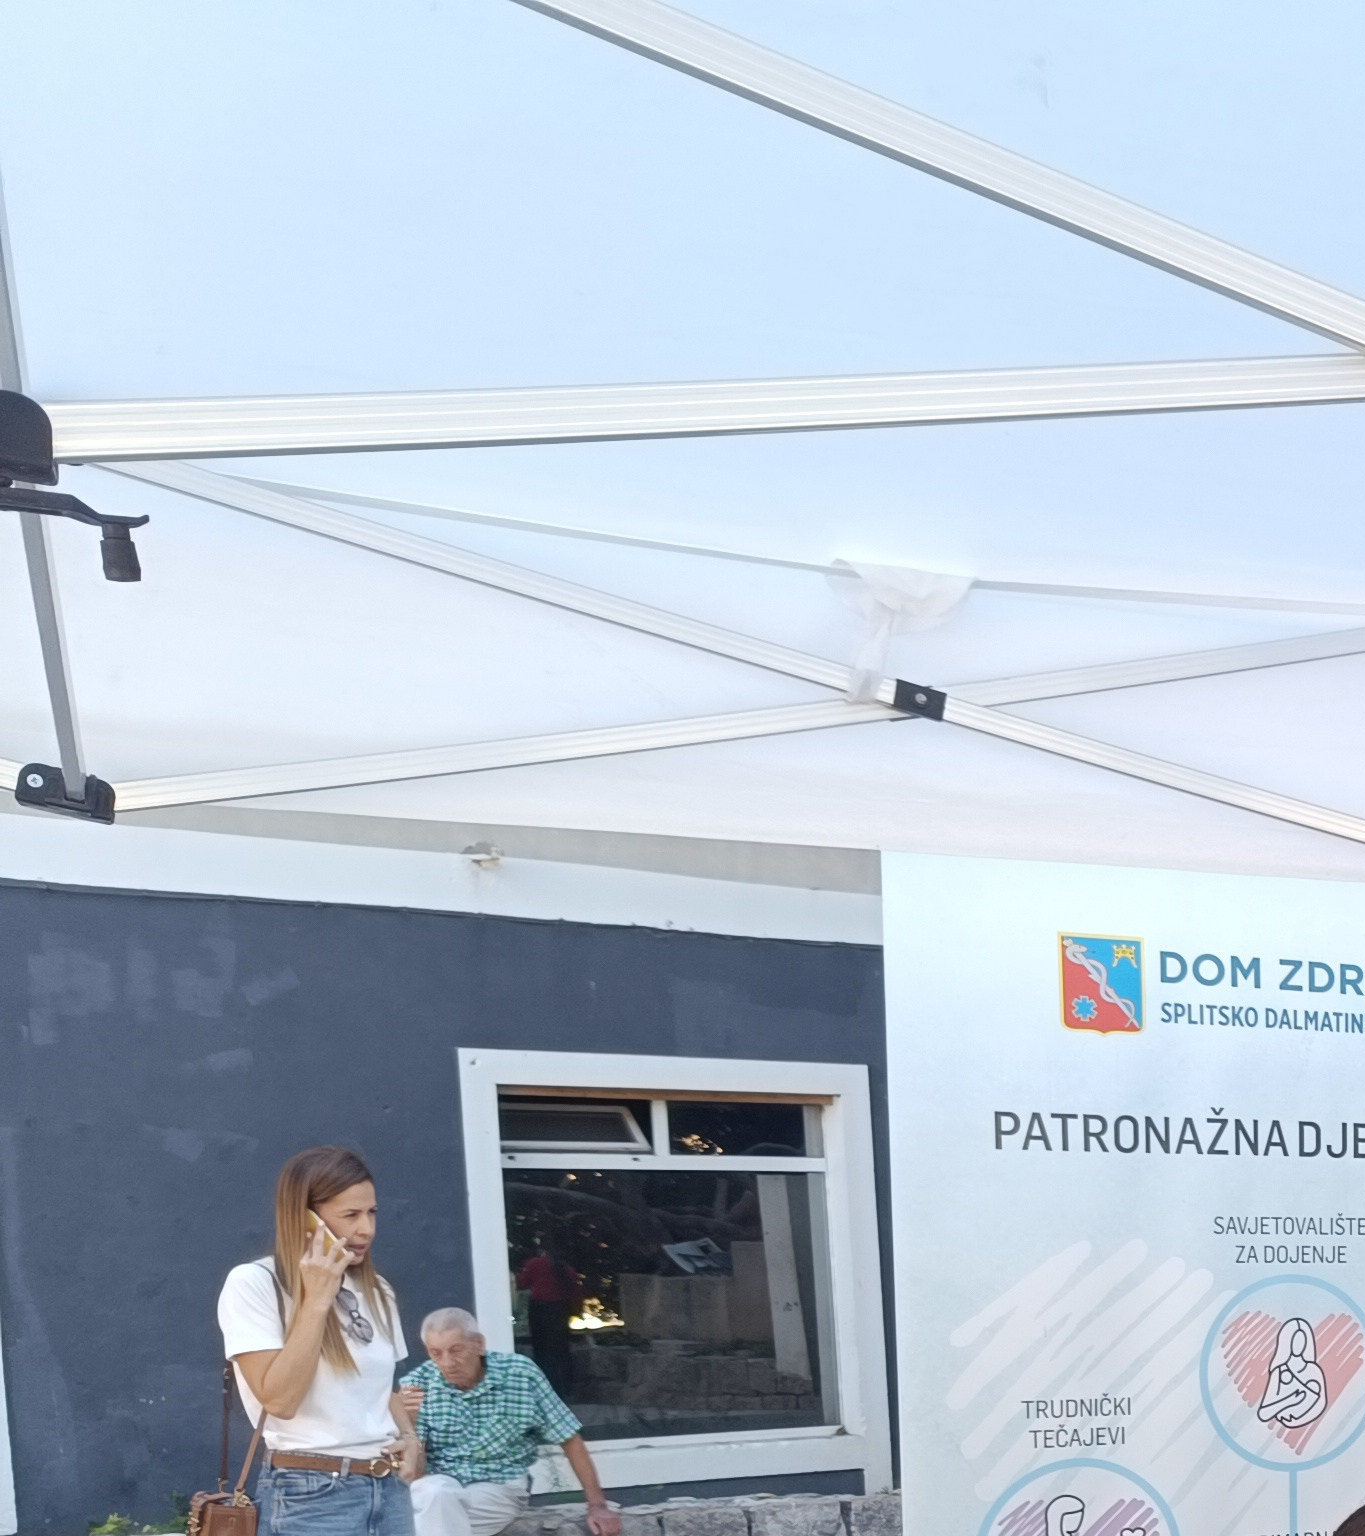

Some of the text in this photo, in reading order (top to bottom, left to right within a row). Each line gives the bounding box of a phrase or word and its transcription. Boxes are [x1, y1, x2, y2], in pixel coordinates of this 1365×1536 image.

[1158, 950, 1262, 990] DOM
[1160, 1001, 1259, 1028] SPLITSKO
[993, 1107, 1289, 1158] PATRONAŽNA
[1235, 1244, 1348, 1265] ZA DOJENJE
[1020, 1395, 1132, 1420] TRUDNIČKI
[1028, 1422, 1126, 1449] TEČAJEVI
